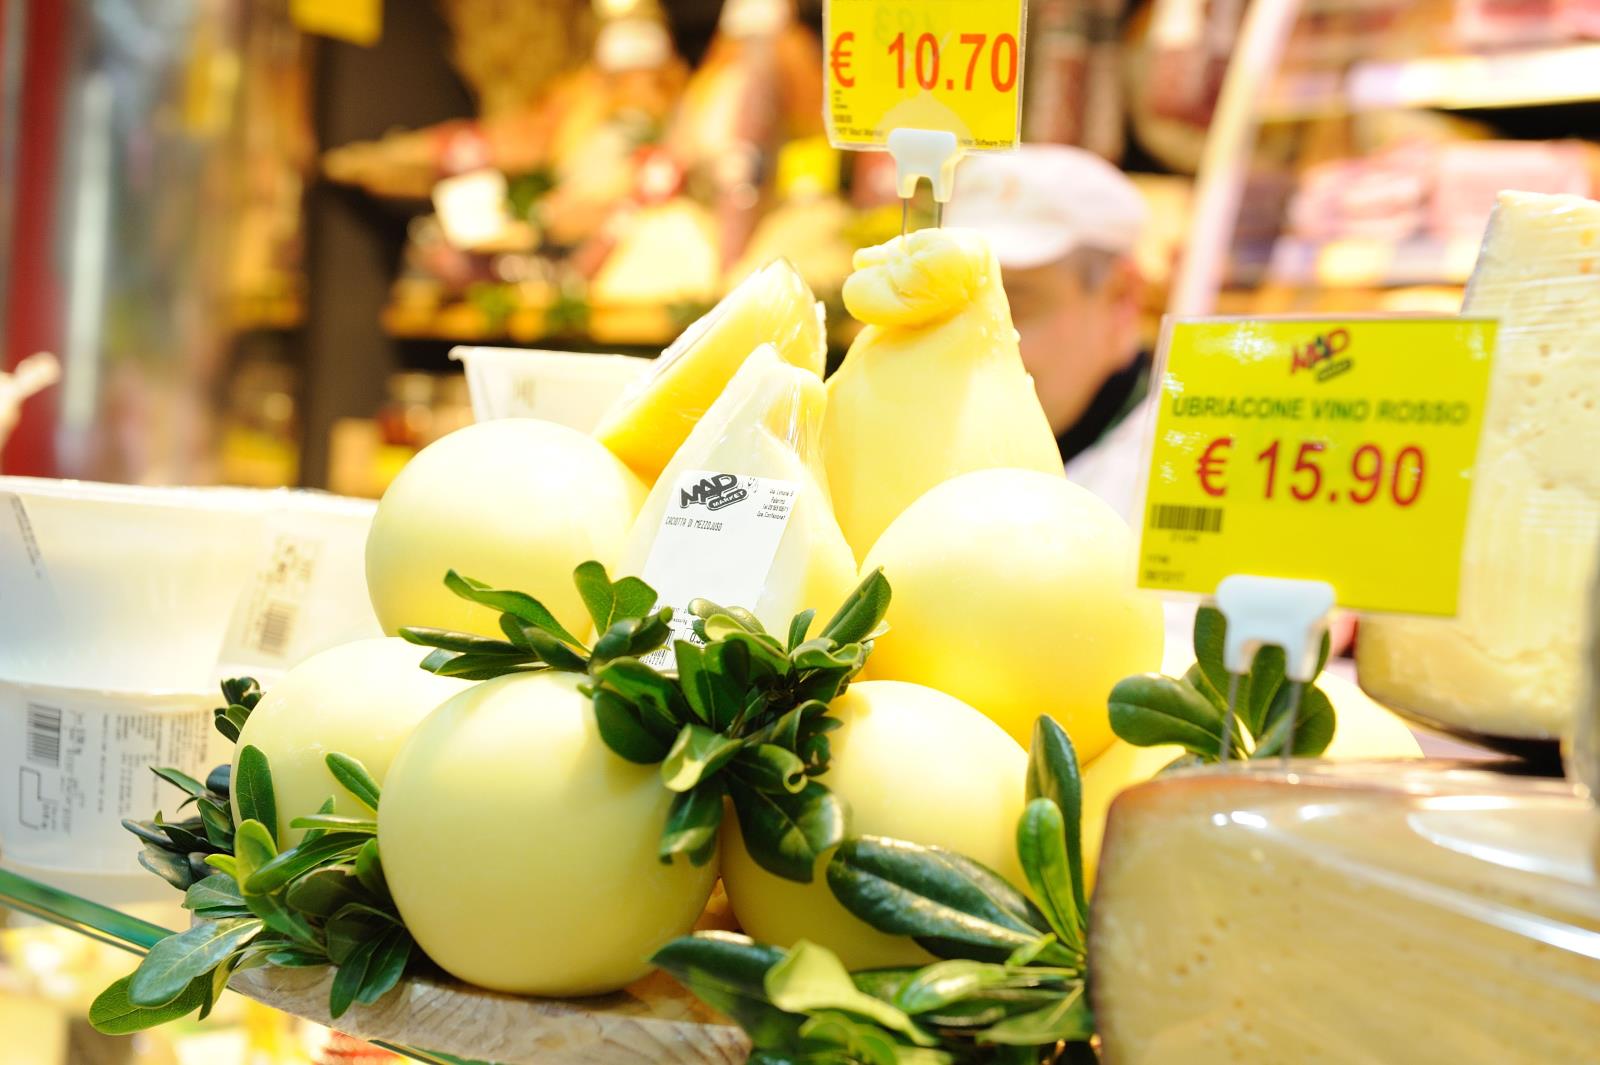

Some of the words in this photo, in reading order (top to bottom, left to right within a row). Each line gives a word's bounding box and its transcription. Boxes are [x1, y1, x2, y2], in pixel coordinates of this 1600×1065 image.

[831, 31, 855, 88] €
[888, 32, 1018, 93] 10.70
[1171, 396, 1304, 422] UBRIACONE
[1311, 398, 1370, 423] VINO
[1375, 400, 1470, 426] ROSSO
[1195, 437, 1232, 497] €
[1256, 438, 1426, 507] 15.90
[680, 474, 738, 508] MAD
[712, 490, 745, 508] MARKET
